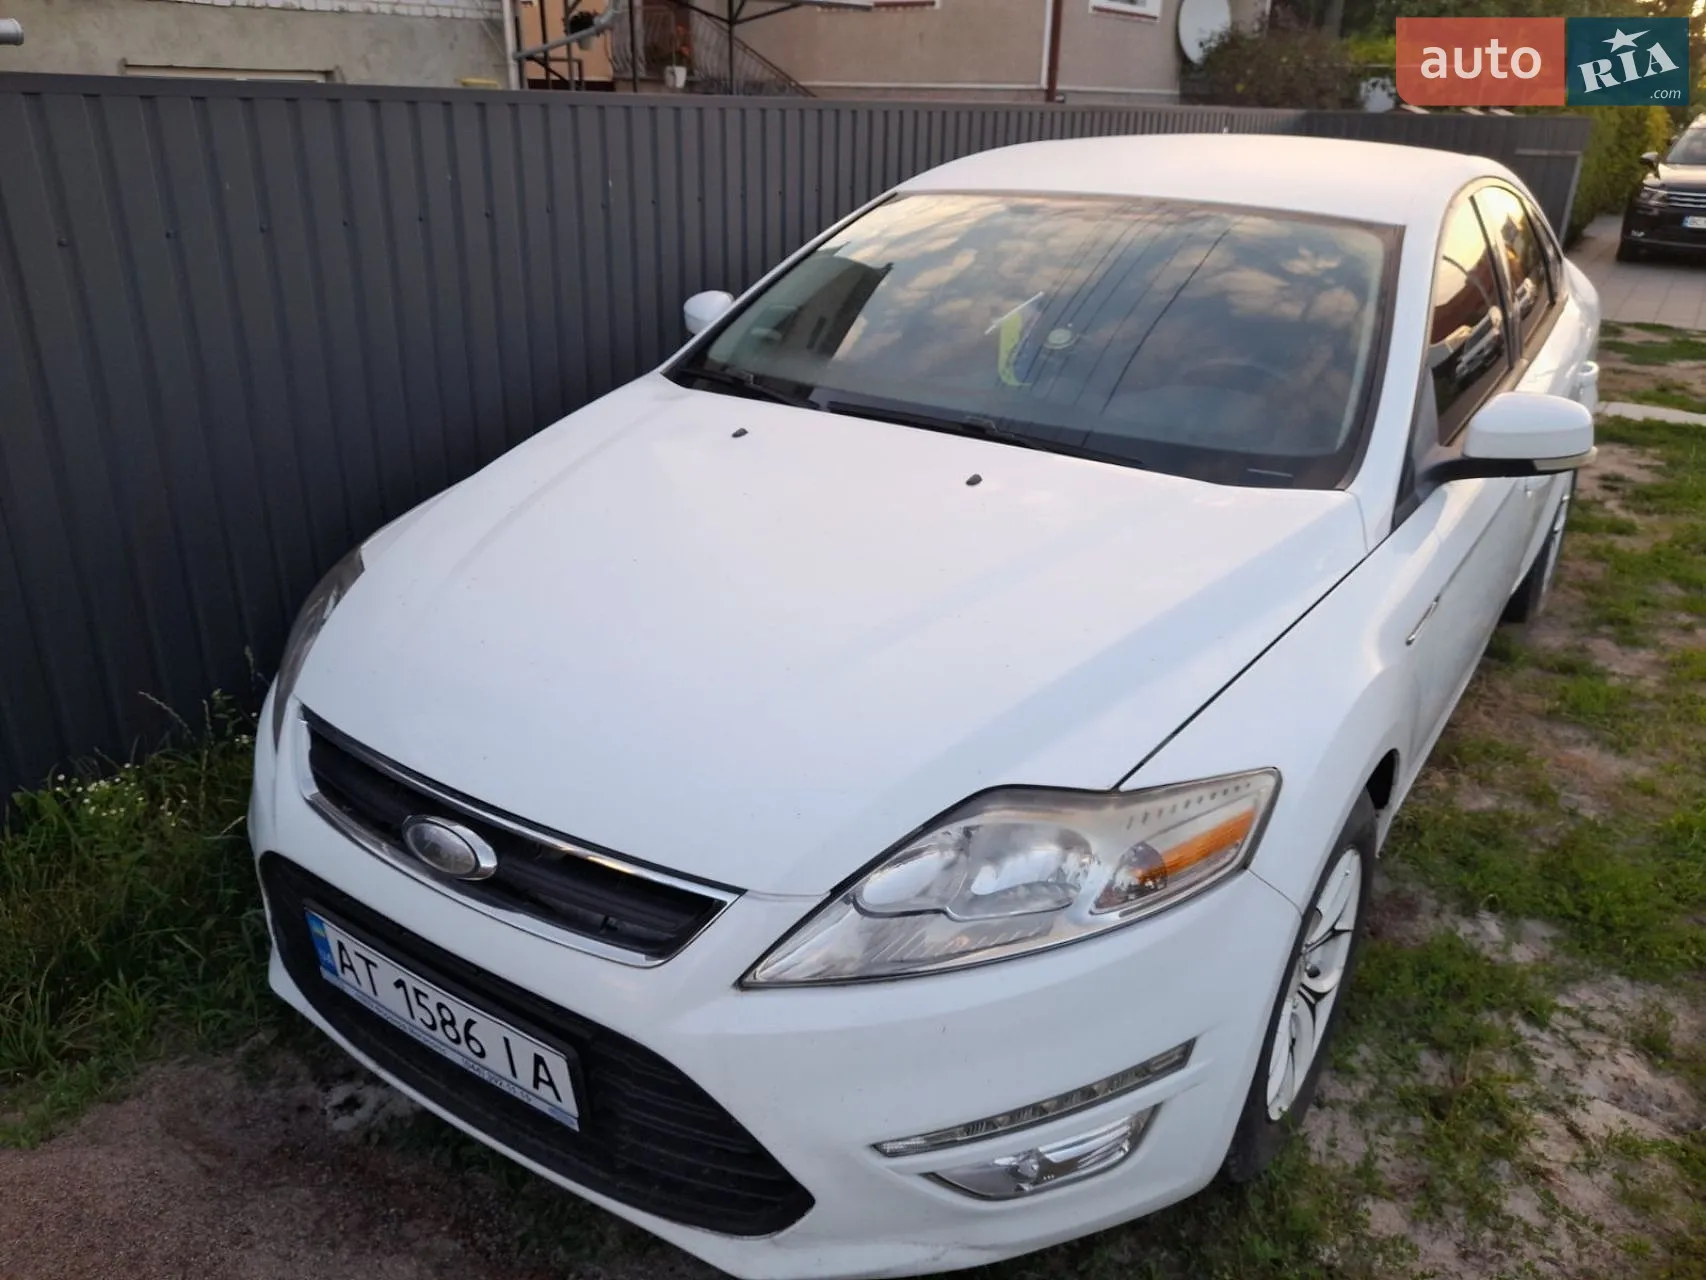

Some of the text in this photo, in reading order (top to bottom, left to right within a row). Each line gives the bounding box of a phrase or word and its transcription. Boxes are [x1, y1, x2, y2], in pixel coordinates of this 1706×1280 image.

[336, 939, 378, 997] AT
[393, 978, 486, 1060] 1586
[503, 1036, 562, 1103] IA
